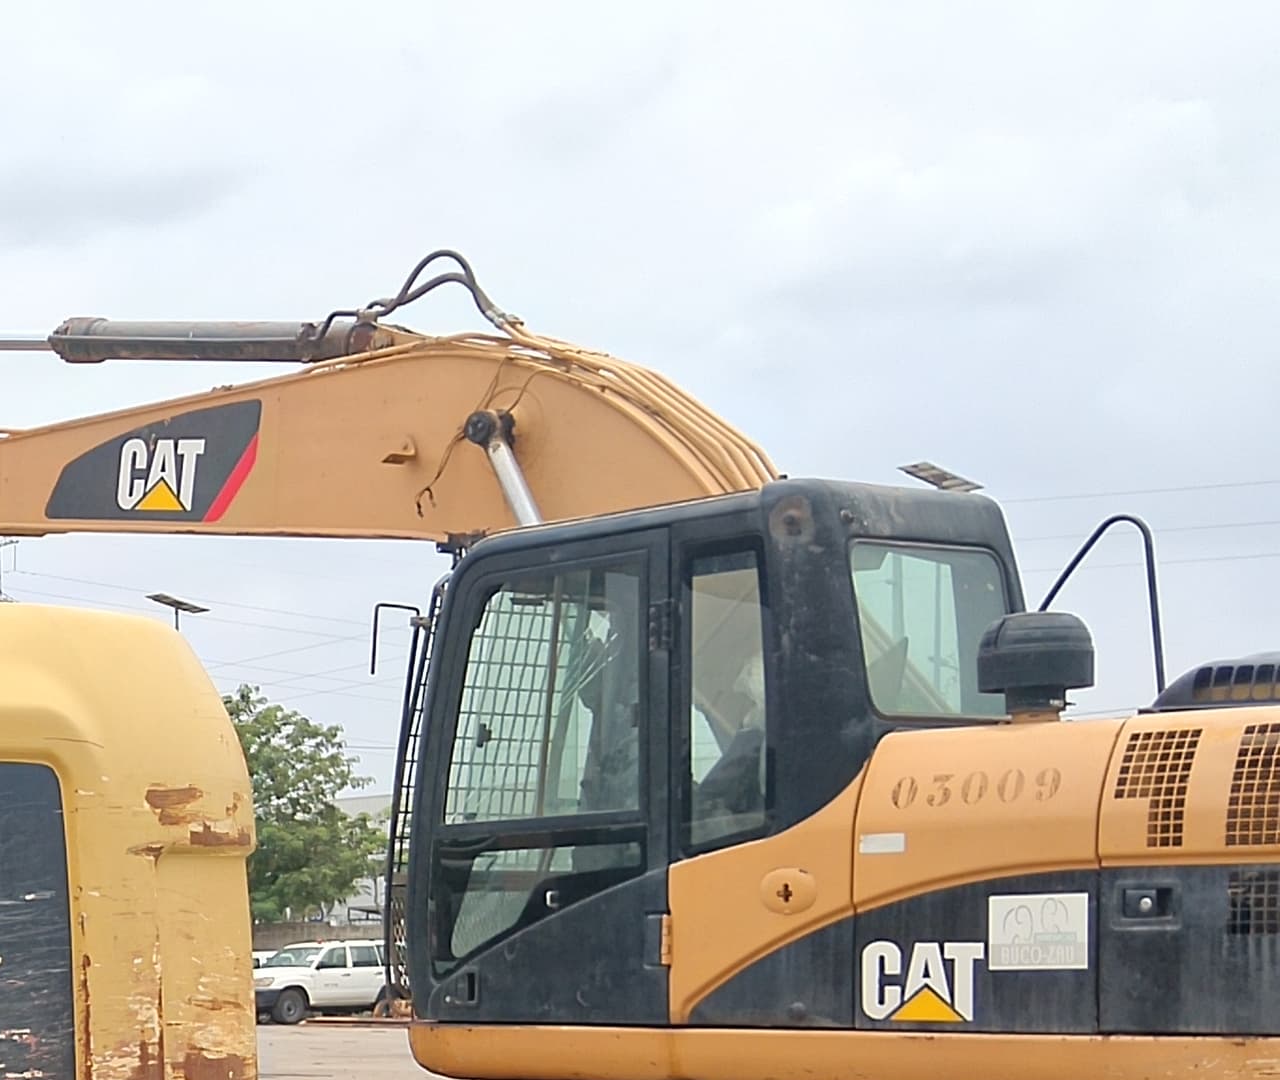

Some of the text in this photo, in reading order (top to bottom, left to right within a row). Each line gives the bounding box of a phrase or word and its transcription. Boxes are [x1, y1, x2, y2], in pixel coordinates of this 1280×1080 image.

[116, 438, 206, 511] CAT
[891, 767, 1062, 809] 03009
[861, 940, 985, 1022] CAT
